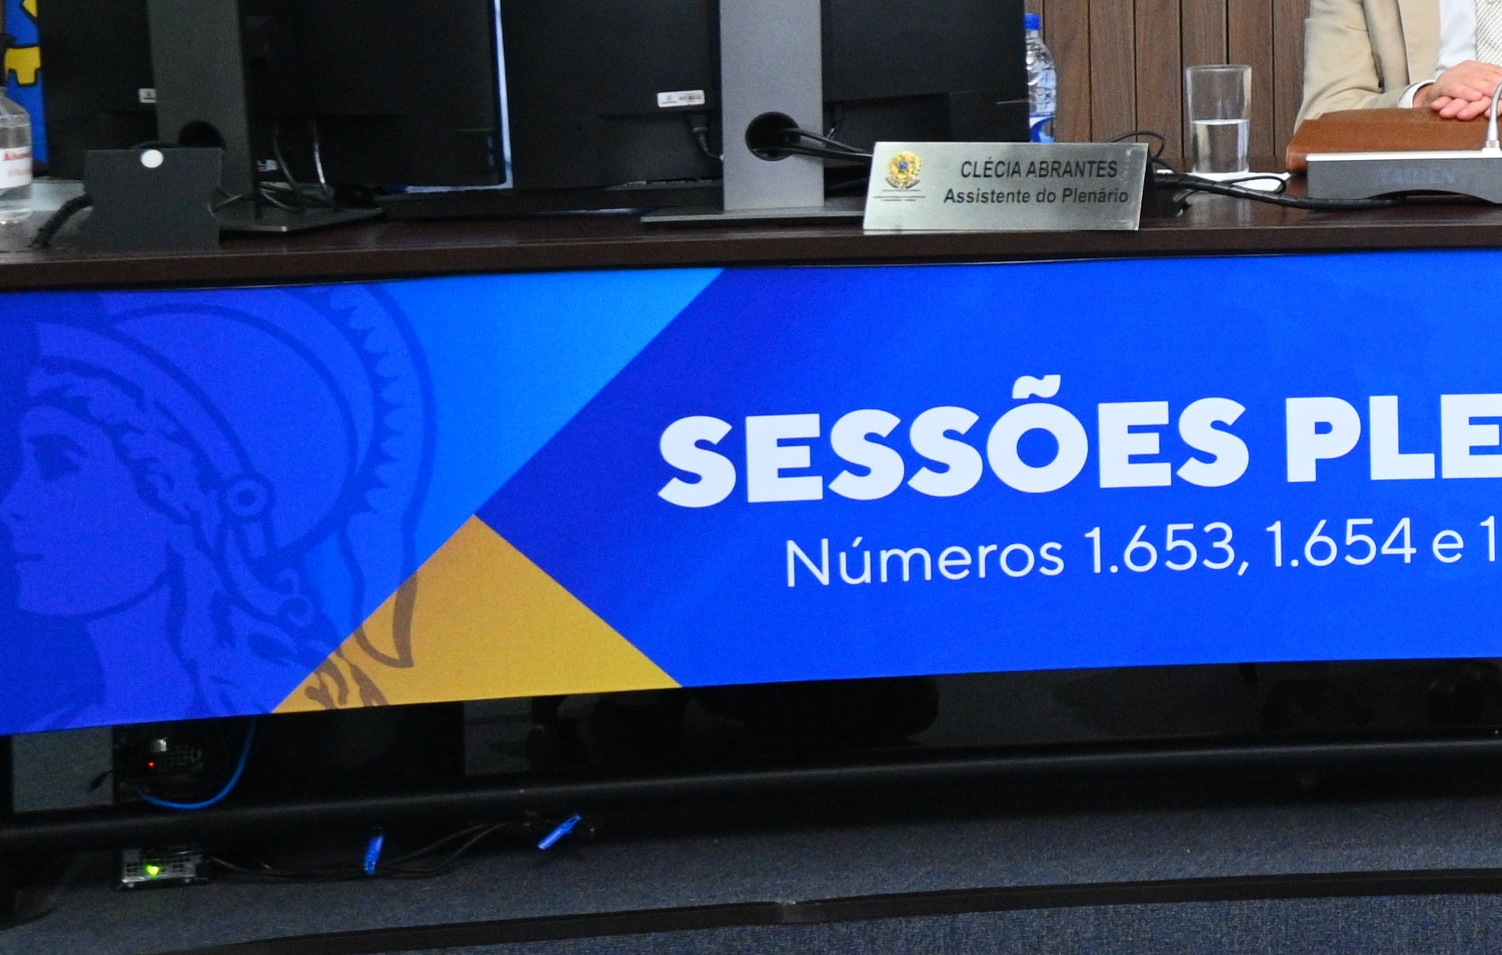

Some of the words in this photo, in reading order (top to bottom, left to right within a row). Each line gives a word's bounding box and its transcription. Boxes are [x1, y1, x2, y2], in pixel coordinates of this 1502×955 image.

[960, 157, 1022, 179] CLÉCIA
[1027, 160, 1118, 179] ABRANTES
[943, 187, 1030, 204] Assistente
[1035, 188, 1057, 204] do
[1062, 186, 1129, 204] Plenário
[658, 374, 1250, 508] SESSÕES
[787, 533, 1065, 587] Números
[1084, 521, 1249, 577] 1.653,
[1266, 517, 1417, 567] 1.654
[1432, 529, 1464, 563] e
